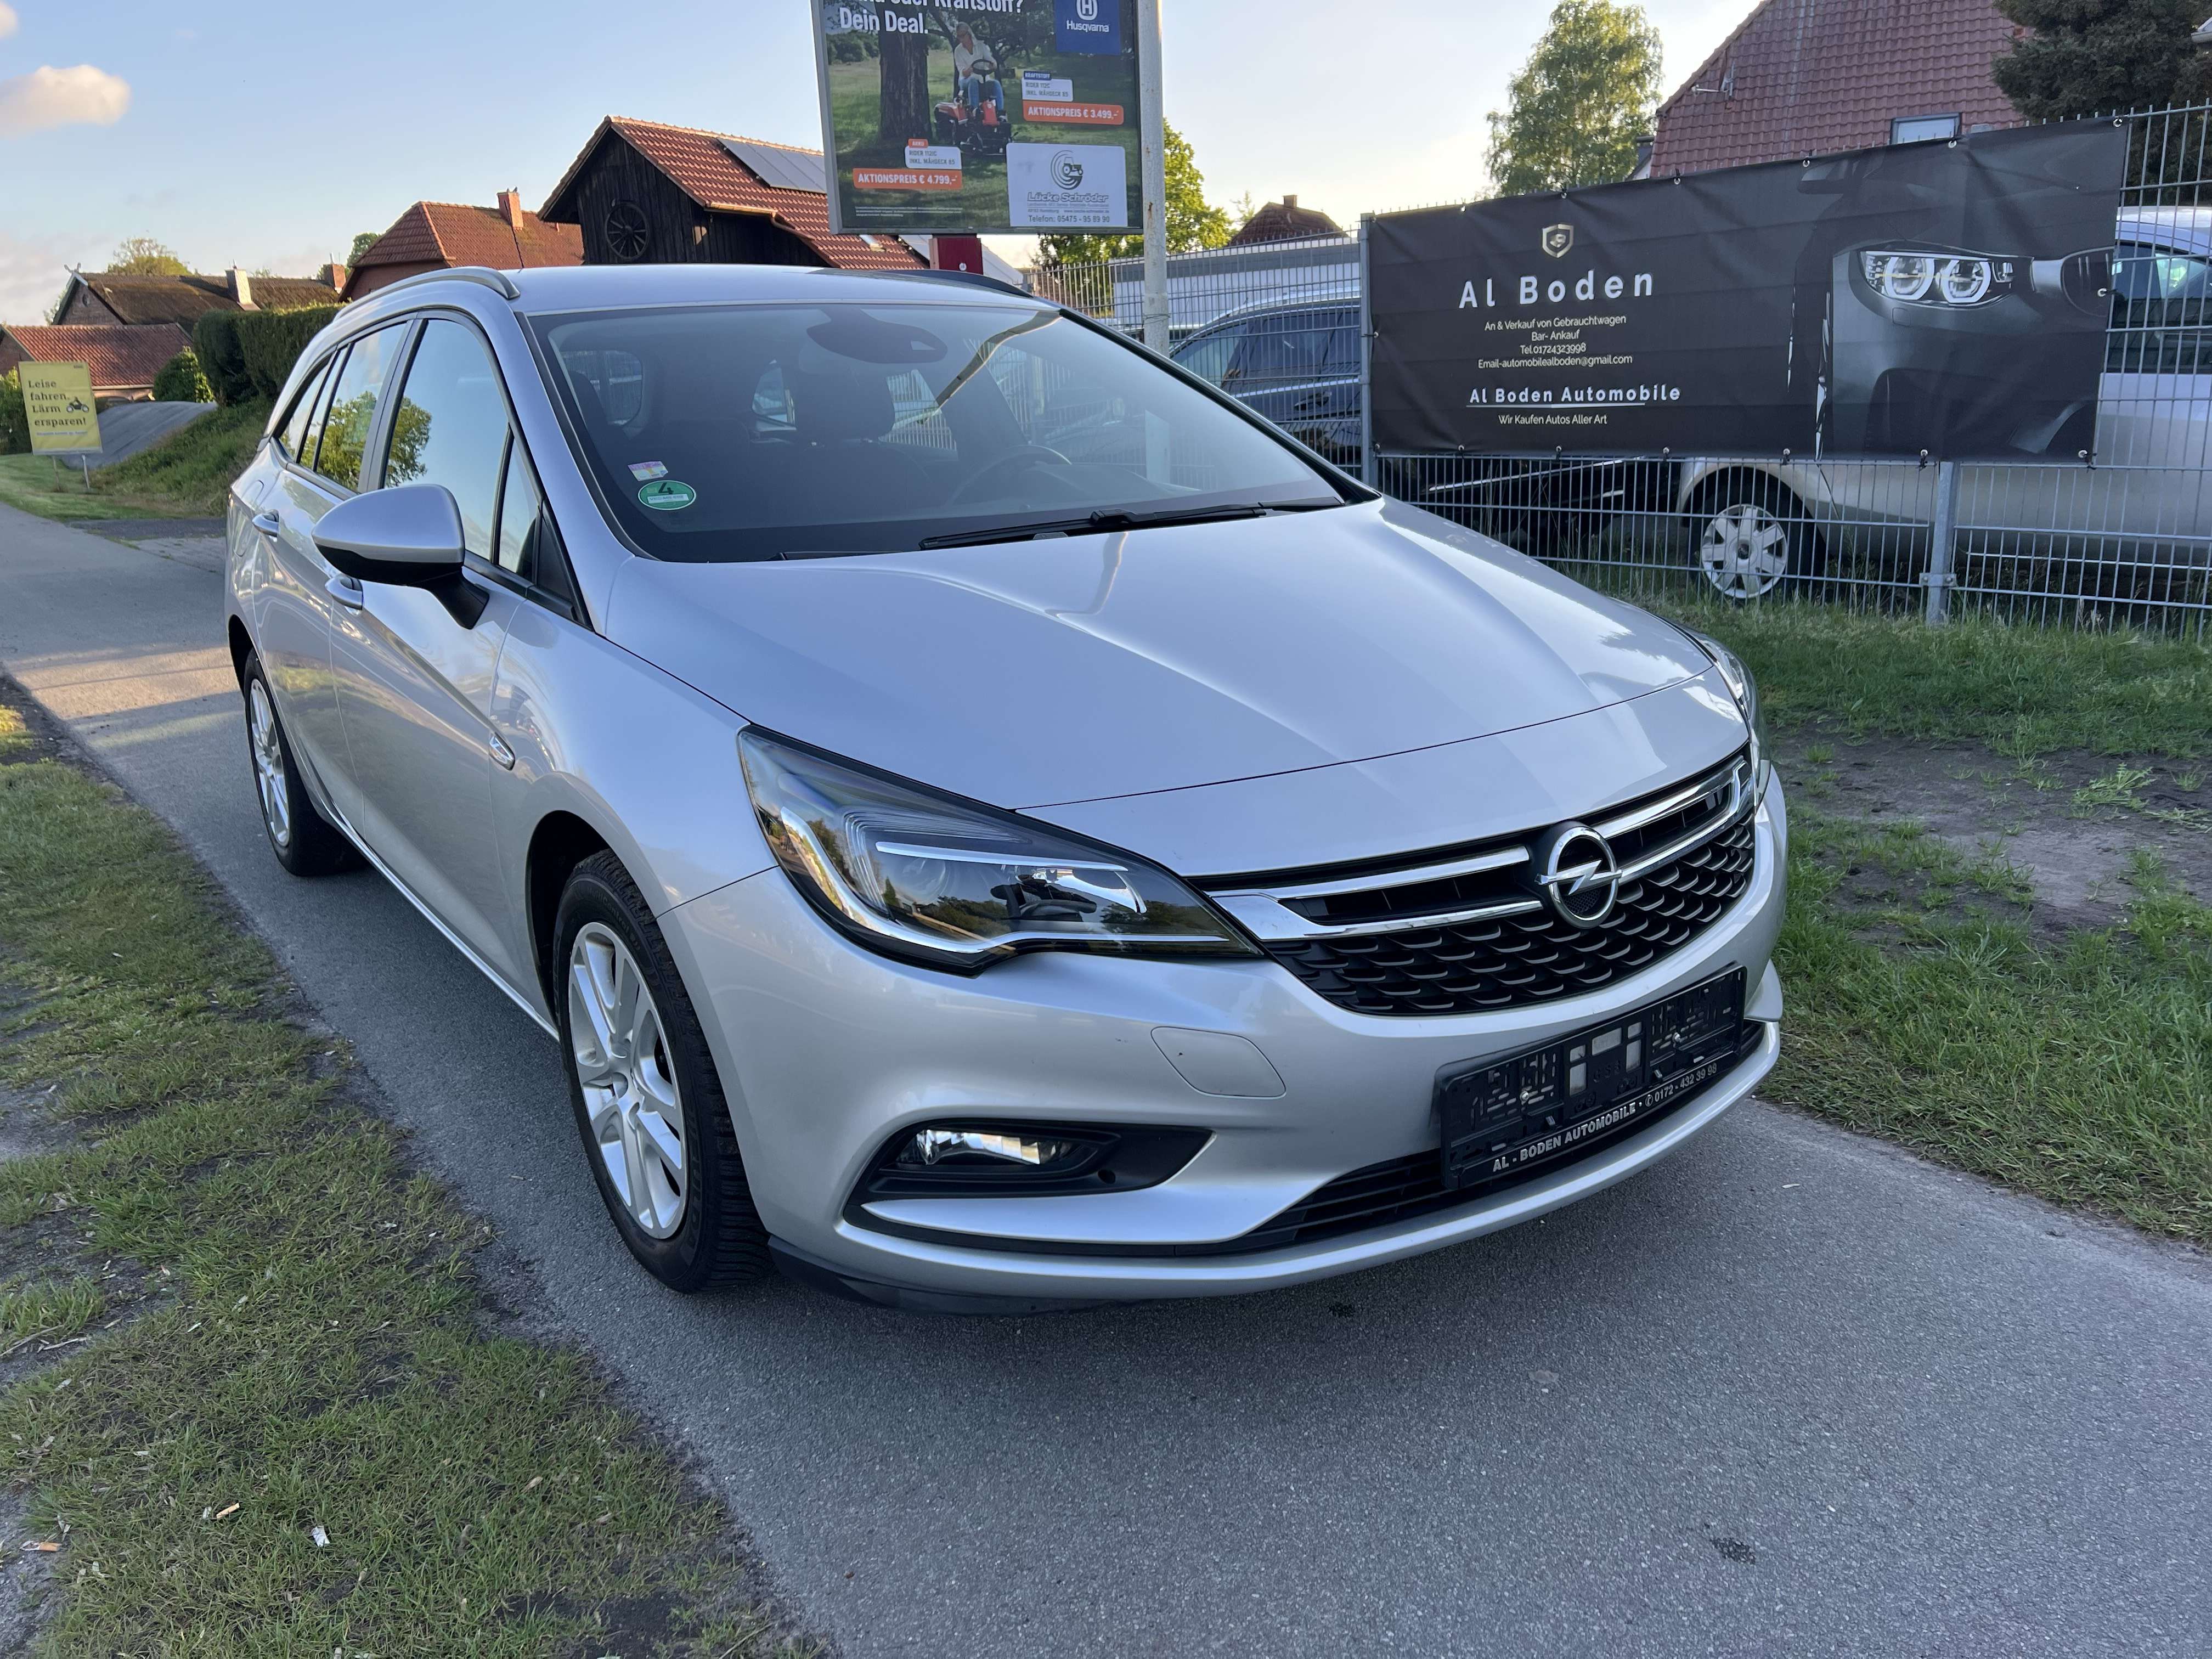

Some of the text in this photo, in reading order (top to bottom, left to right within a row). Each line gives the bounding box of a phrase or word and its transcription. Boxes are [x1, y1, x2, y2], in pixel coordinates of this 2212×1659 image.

[839, 7, 929, 34] Dein Deal.
[1066, 20, 1109, 32] Husqvarna
[1028, 106, 1082, 117] AKTIONSPREIS
[858, 173, 917, 184] AKTIONSPREIS
[918, 175, 924, 184] €
[1027, 192, 1109, 203] Lücke Schröder
[1459, 269, 1652, 309] Al Boden
[1485, 315, 1626, 331] An & Verkauf von Gebrauchtwagen
[1531, 329, 1581, 341] Bar- Ankauf
[1478, 355, 1633, 369] Email-automobilealboden@gmail.com
[28, 379, 57, 388] Leise
[1470, 383, 1681, 403] Al Boden Automobile
[32, 404, 61, 413] Lärm
[35, 417, 86, 428] ersparen!
[1498, 414, 1607, 425] Wir Kaufen Autos Aller Art
[658, 482, 674, 494] 4
[588, 887, 630, 932] MultiControl
[1493, 1156, 1509, 1172] AL
[1520, 1135, 1562, 1162] BODEN
[1564, 1102, 1636, 1143] AUTOMOBILE
[1655, 1084, 1673, 1102] 0172
[1680, 1074, 1694, 1088] 432
[1696, 1068, 1706, 1081] 39
[1707, 1062, 1717, 1076] 98
